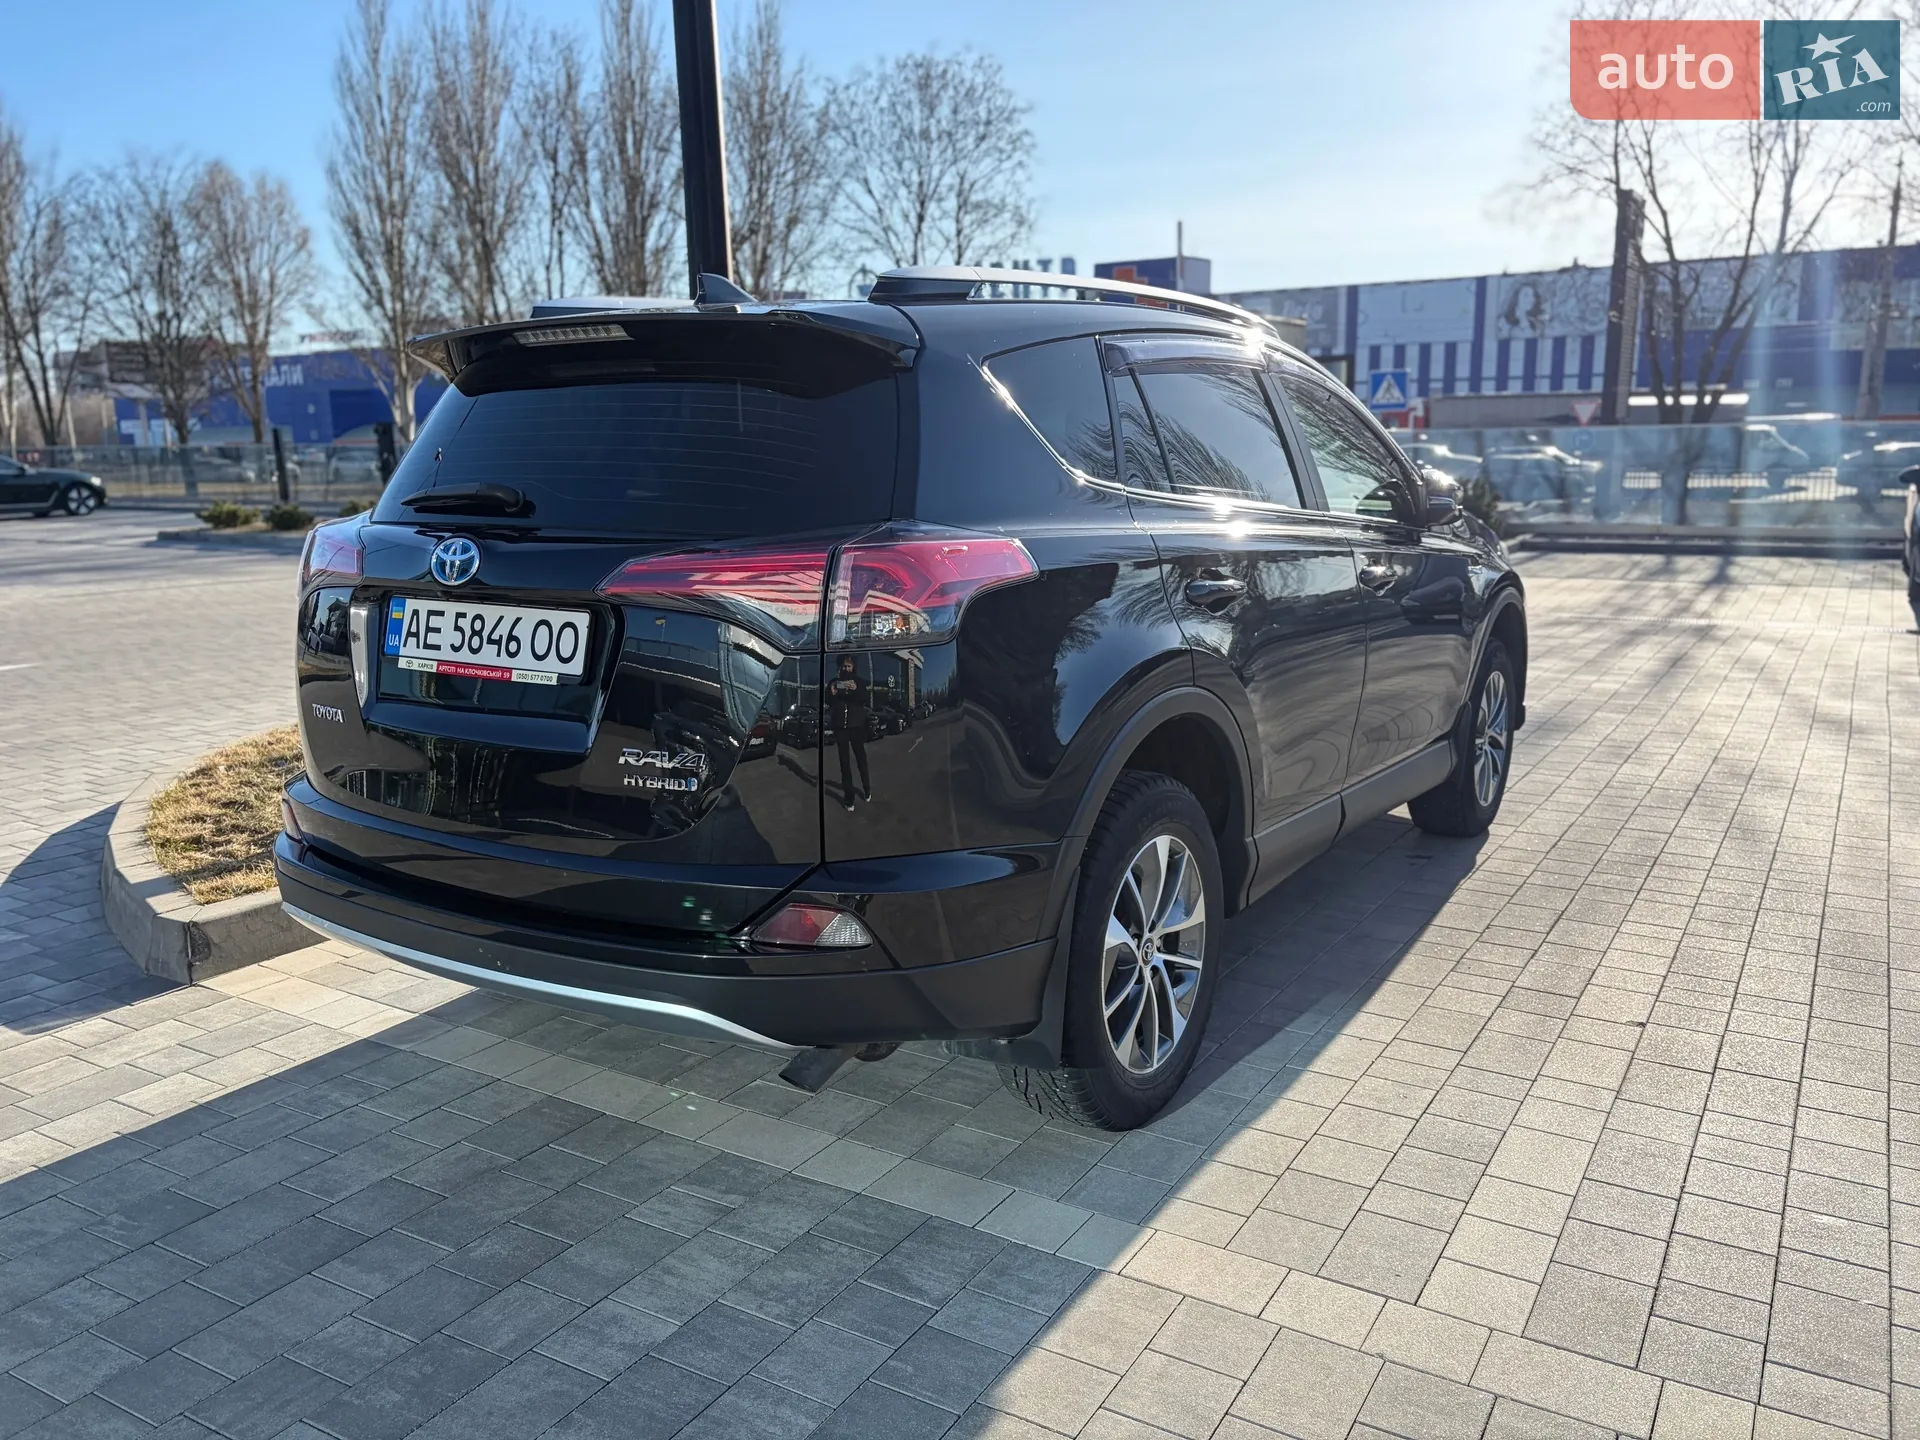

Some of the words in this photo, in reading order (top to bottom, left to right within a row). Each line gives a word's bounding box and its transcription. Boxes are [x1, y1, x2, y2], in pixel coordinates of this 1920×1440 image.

[388, 634, 400, 647] UA
[402, 608, 446, 651] AE
[449, 612, 523, 659] 5846
[417, 662, 434, 670] ХАРКІВ
[457, 666, 465, 674] НА
[503, 671, 510, 679] 59
[516, 672, 530, 681] (050)
[311, 703, 345, 723] TOYOTA
[618, 747, 707, 773] RAV4
[623, 774, 686, 791] HYBRID
